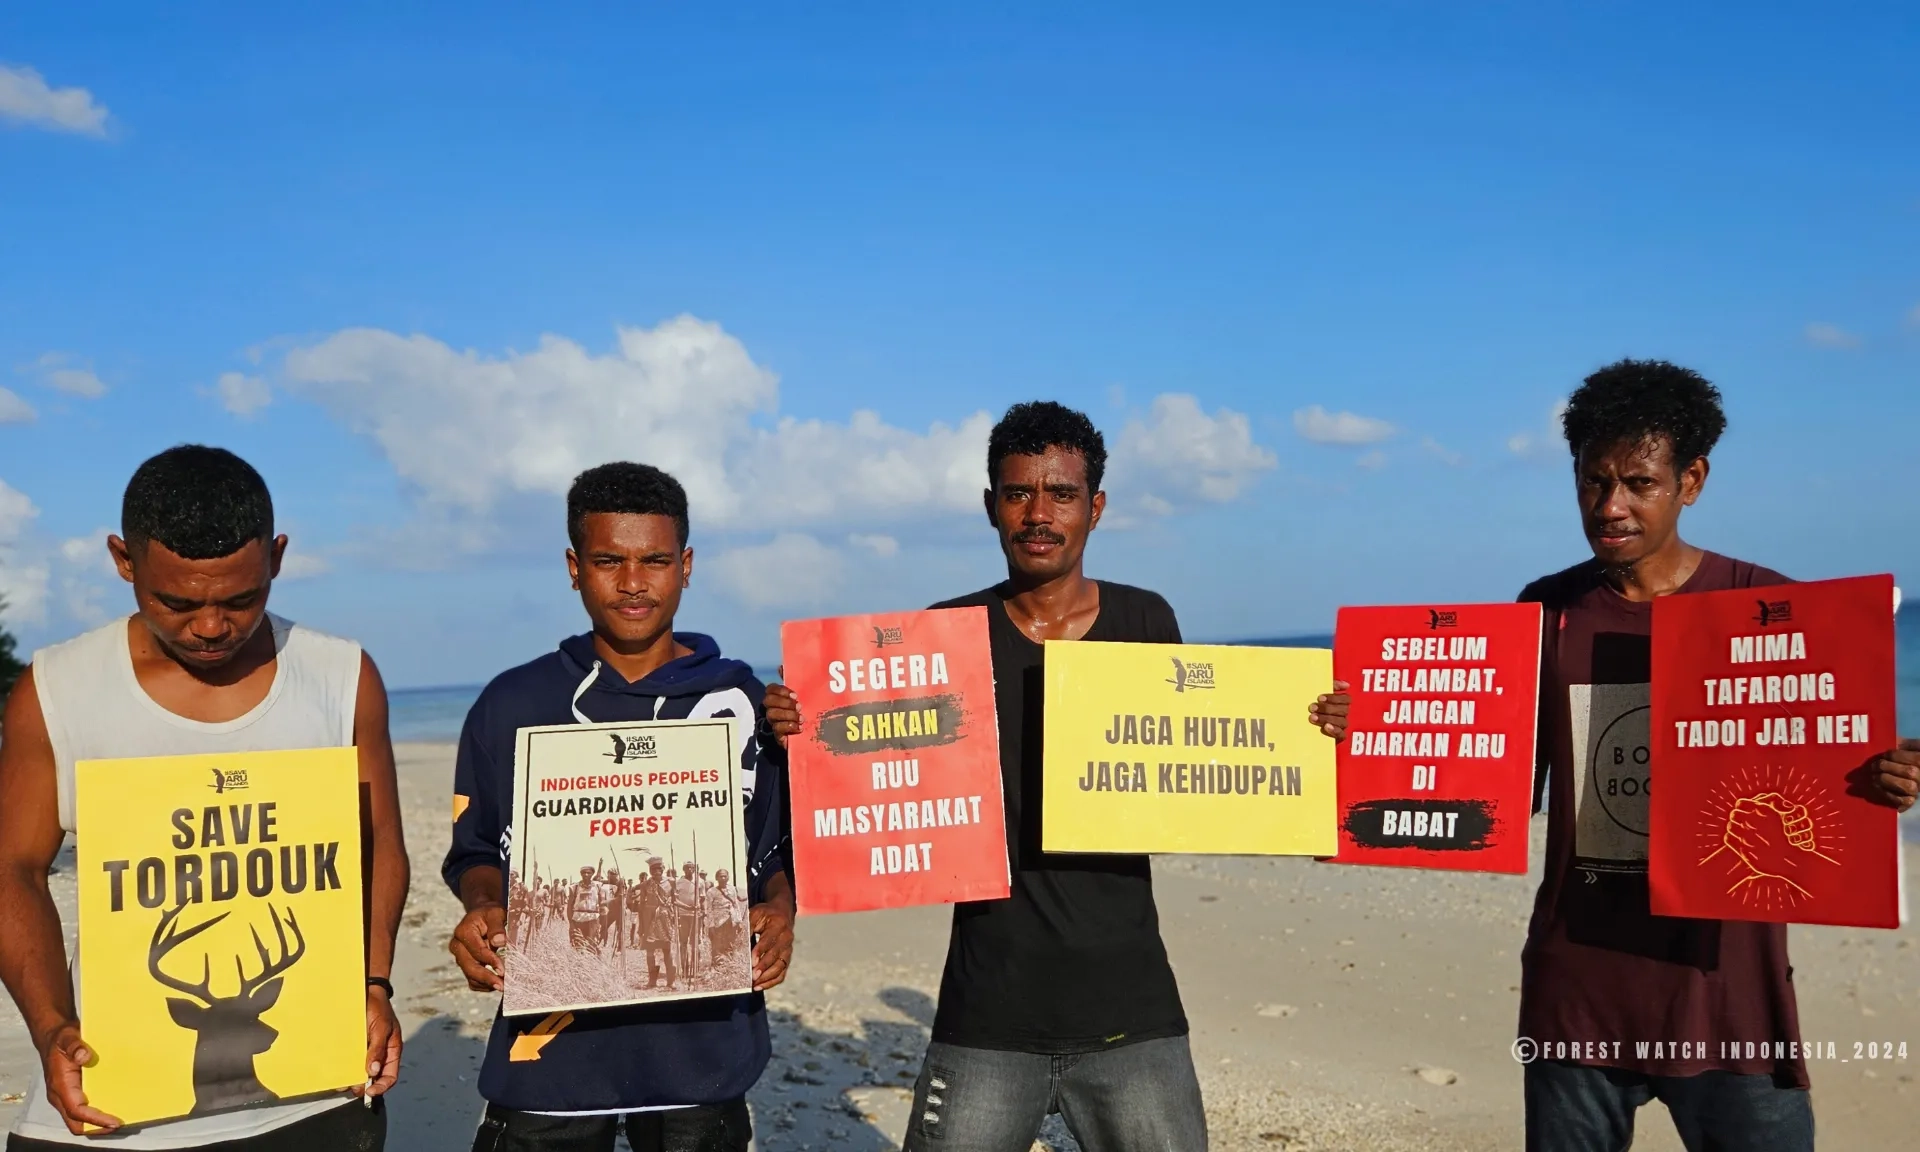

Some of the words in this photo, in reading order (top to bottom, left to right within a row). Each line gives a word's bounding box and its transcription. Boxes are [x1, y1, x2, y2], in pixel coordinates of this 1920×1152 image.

[1381, 637, 1487, 661] SEBELUM
[1731, 633, 1806, 663] MIMA
[828, 653, 949, 693] SEGERA
[1188, 669, 1214, 679] ARU
[1362, 669, 1503, 695] TERLAMBAT,
[1704, 673, 1835, 705] TAFARONG
[846, 709, 938, 742] SAHKAN
[1383, 701, 1475, 725] JANGAN
[1105, 714, 1173, 746] JAGA
[1184, 716, 1275, 752] HUTAN,
[1351, 731, 1450, 757] BIARKAN
[1458, 733, 1506, 758] ARU
[1676, 719, 1745, 747] TADOI
[1756, 717, 1806, 746] JAR
[1817, 714, 1869, 743] NEN
[627, 741, 656, 751] ARU
[540, 773, 643, 792] INDIGENOUS
[648, 769, 719, 786] PEOPLES
[871, 759, 920, 790] RUU
[1078, 761, 1148, 793] JAGA
[1158, 763, 1302, 796] KEHIDUPAN
[1412, 765, 1436, 790] DI
[532, 795, 645, 819] GUARDIAN
[652, 793, 679, 811] OF
[685, 789, 728, 809] ARU
[814, 796, 982, 837] MASYARAKAT
[171, 802, 278, 850] SAVE
[589, 815, 673, 838] FOREST
[1382, 810, 1459, 838] BABAT
[870, 842, 933, 876] ADAT
[102, 841, 342, 912] TORDOUK
